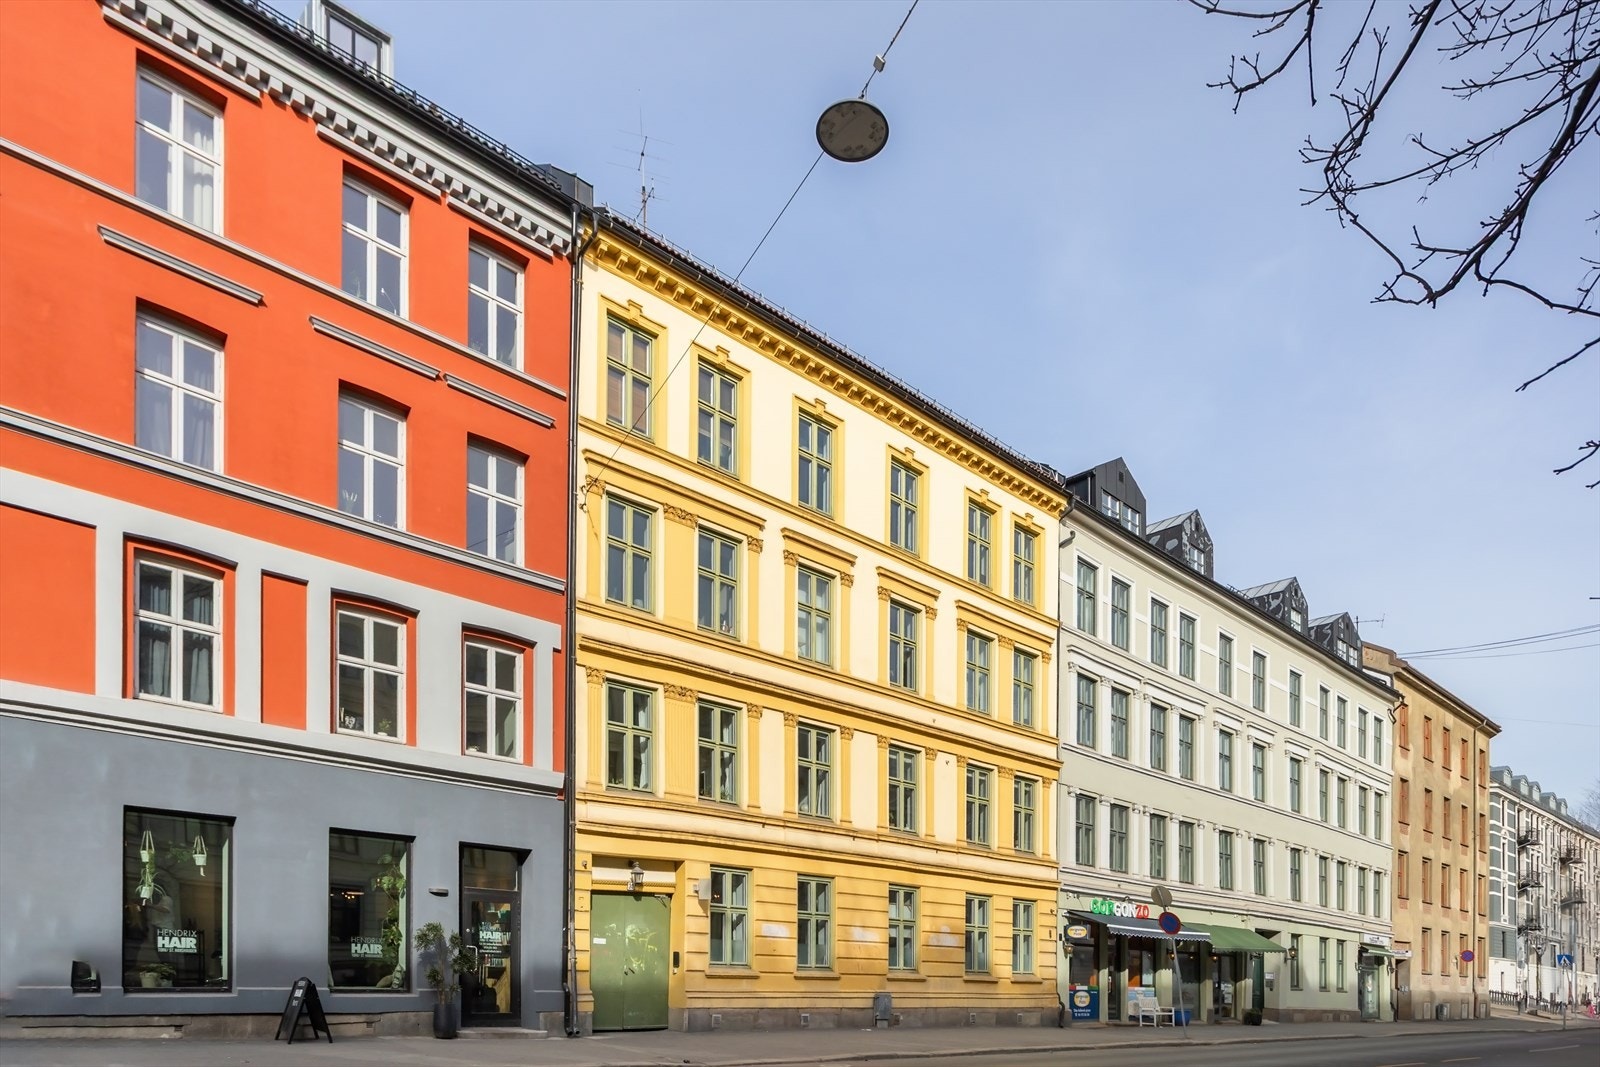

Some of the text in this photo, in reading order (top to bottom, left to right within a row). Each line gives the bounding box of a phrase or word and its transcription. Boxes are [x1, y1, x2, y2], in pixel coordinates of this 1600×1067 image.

[1091, 898, 1150, 919] GORGONZO
[157, 929, 197, 937] HENDRIX
[480, 931, 501, 939] HAIR
[157, 936, 197, 949] HAIR
[351, 936, 385, 944] HENDRIX
[351, 943, 383, 954] HAIR
